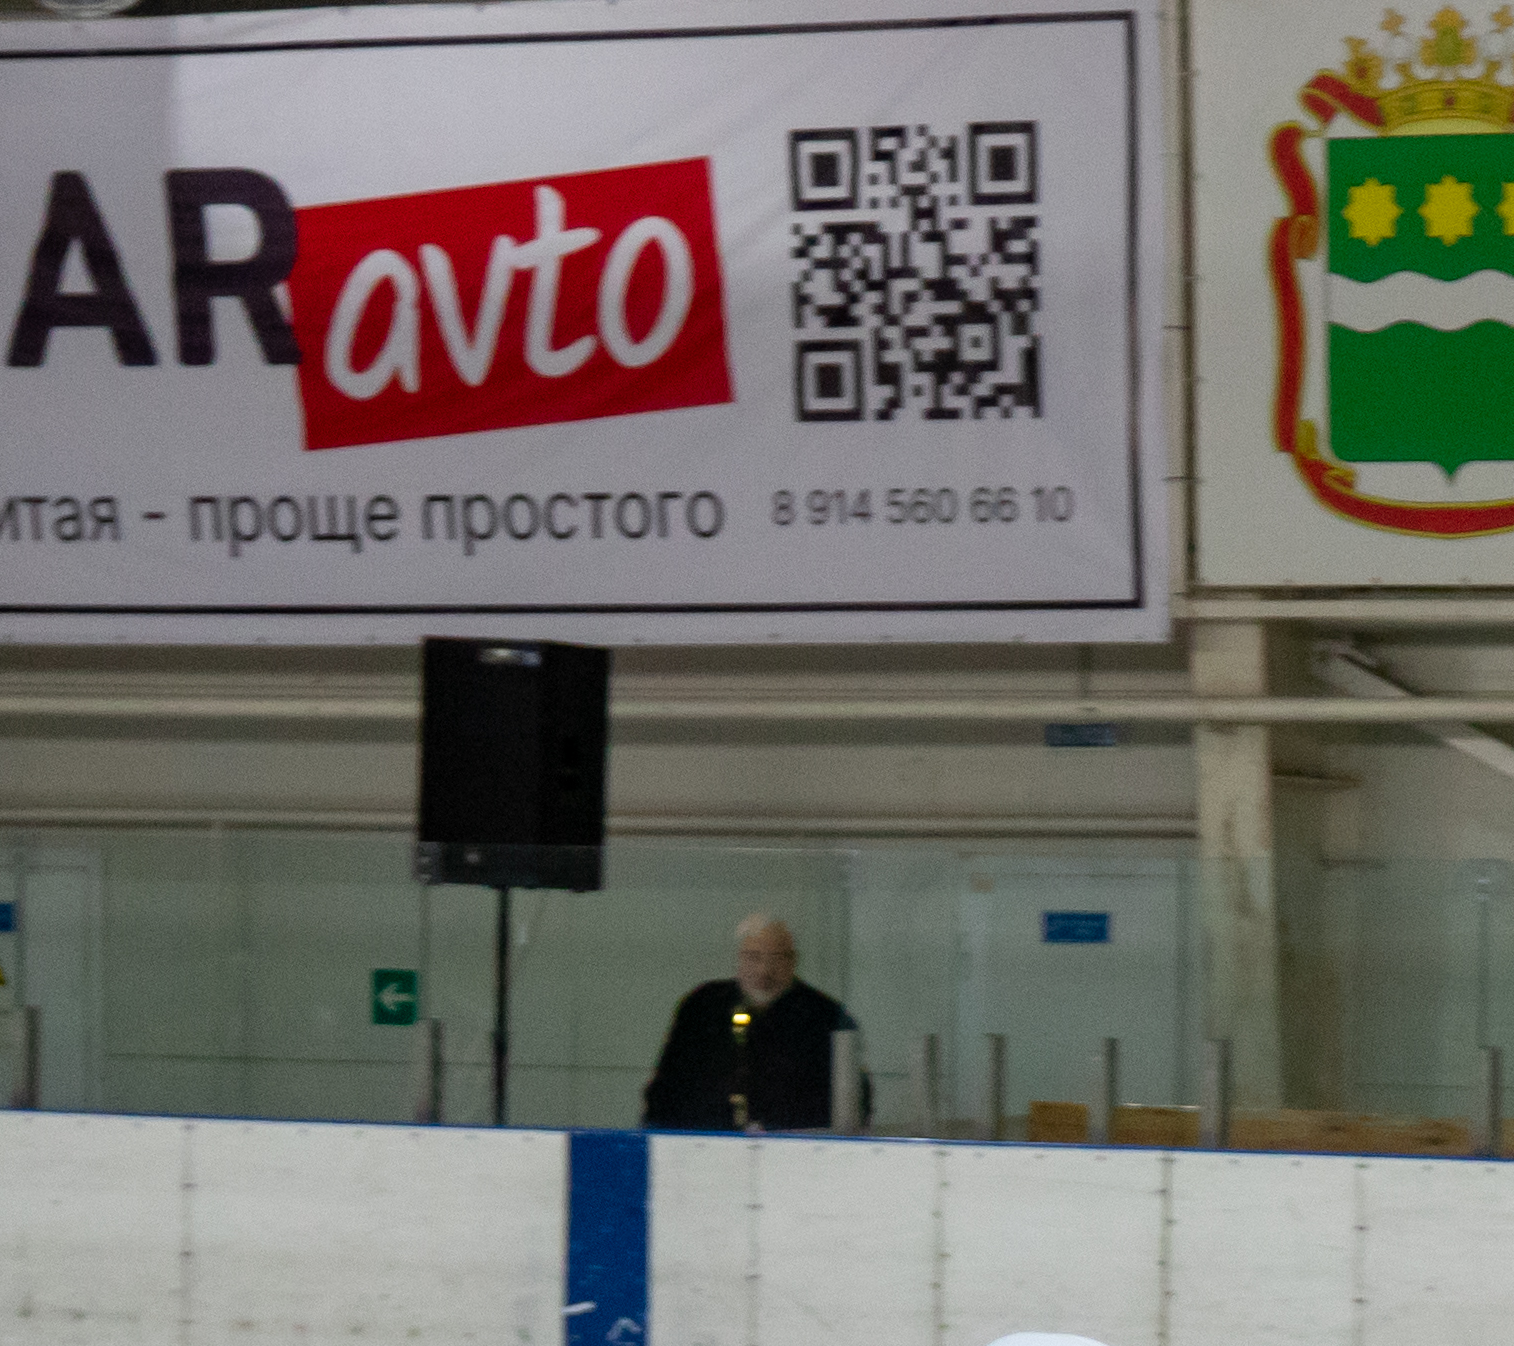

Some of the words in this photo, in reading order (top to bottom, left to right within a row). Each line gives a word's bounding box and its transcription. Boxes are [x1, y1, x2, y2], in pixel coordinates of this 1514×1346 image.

[324, 185, 695, 400] avto
[142, 508, 166, 521] -
[190, 494, 400, 556] проще
[421, 489, 726, 556] простого
[772, 490, 791, 526] 8
[804, 488, 872, 526] 914
[888, 487, 955, 525] 560
[970, 486, 1020, 525] 66
[1031, 485, 1074, 523] 10
